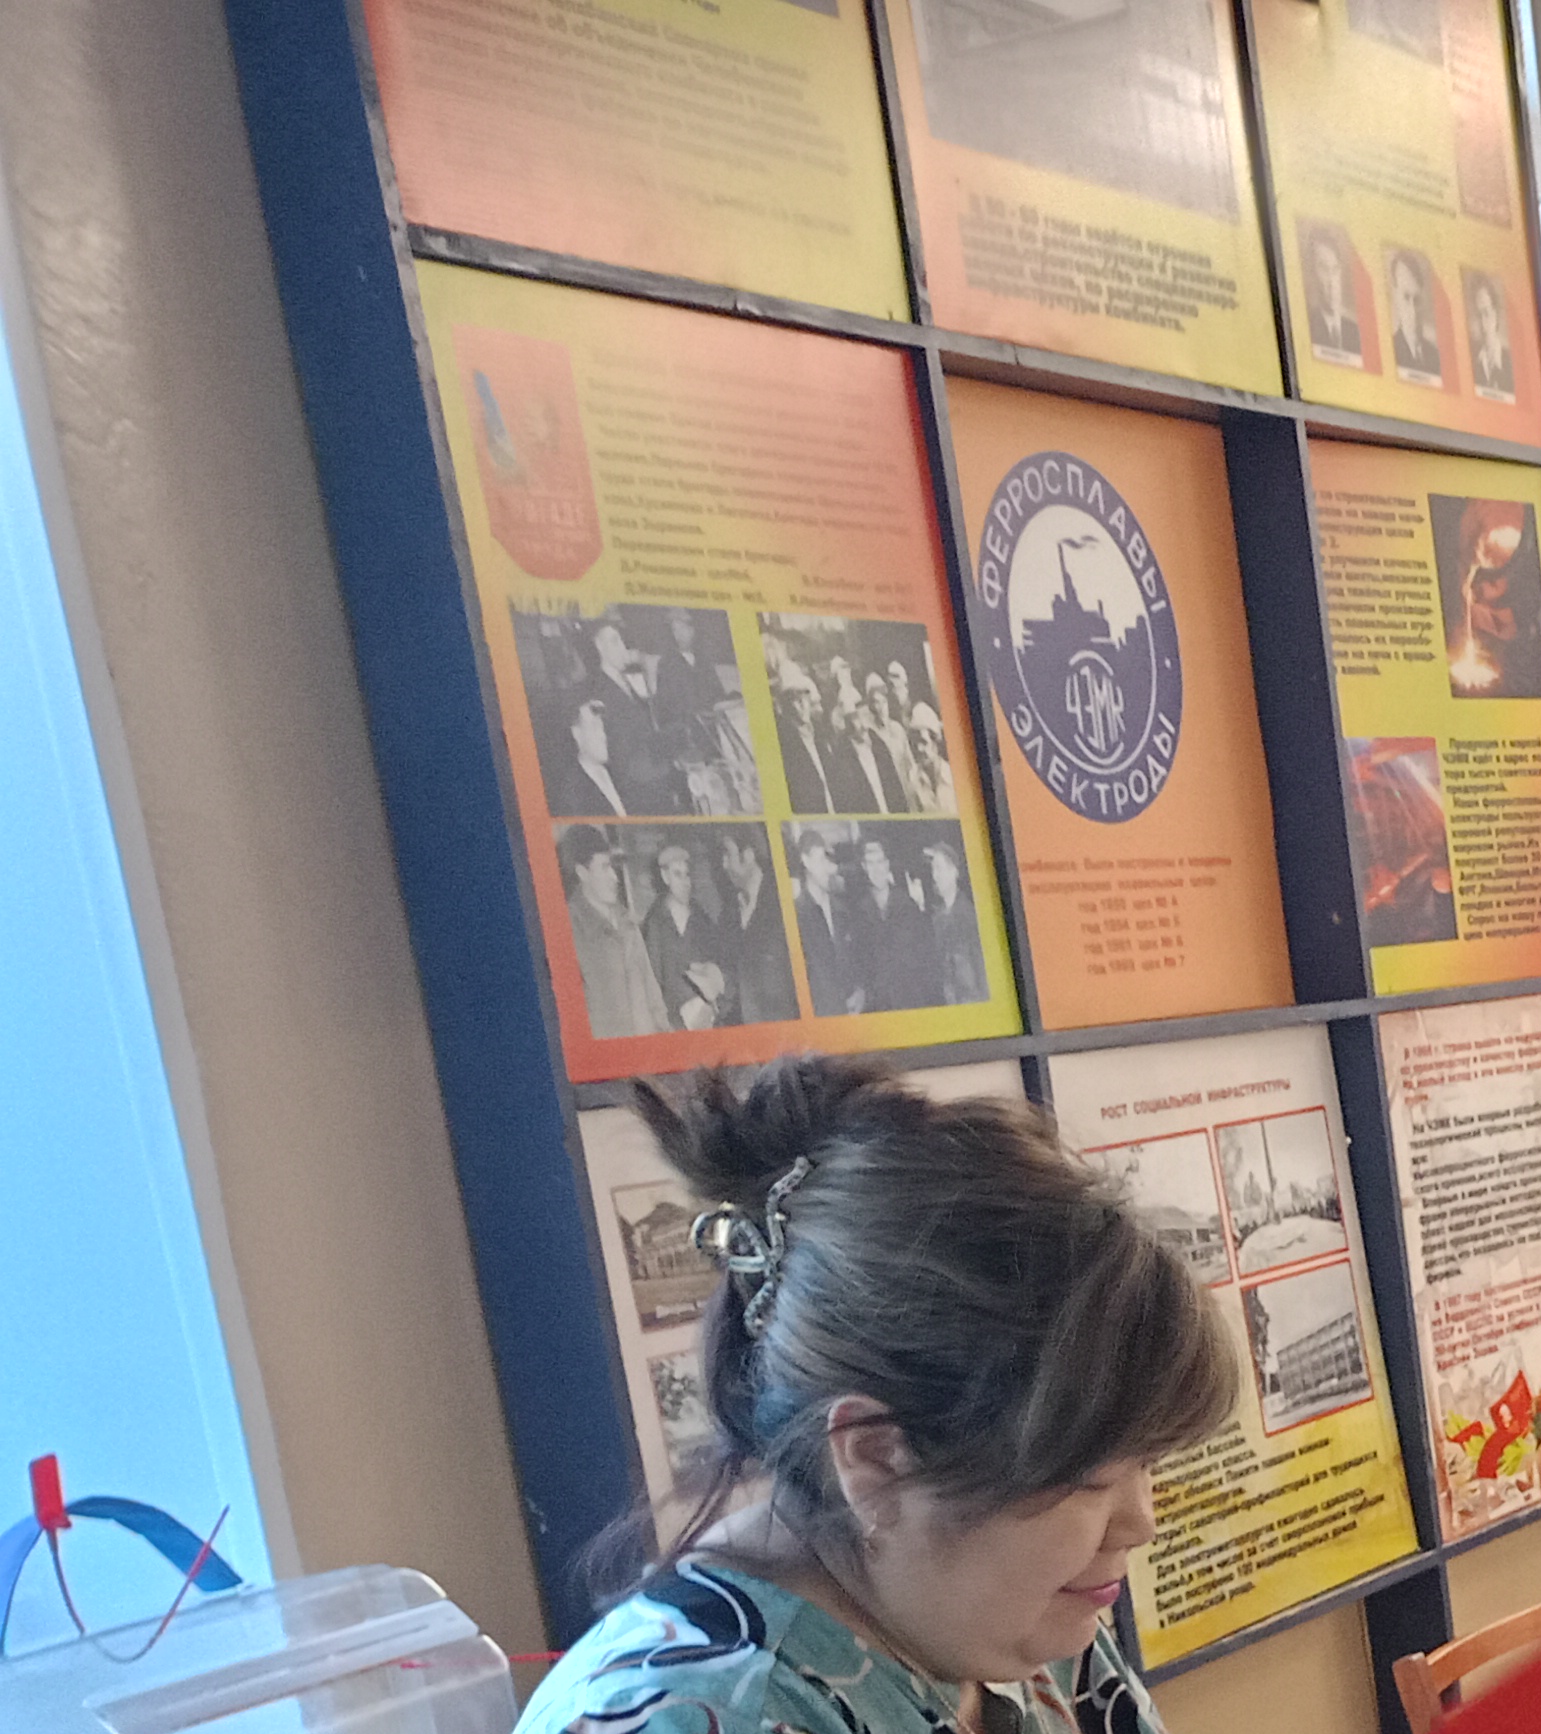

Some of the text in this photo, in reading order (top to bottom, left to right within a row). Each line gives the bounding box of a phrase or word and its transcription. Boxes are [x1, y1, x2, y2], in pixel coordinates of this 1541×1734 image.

[982, 459, 1168, 613] ФЕРРОСПЛАВЫ
[1011, 704, 1175, 816] ЭЛЕКТРОДЫ
[1100, 1078, 1291, 1120] РОСТ СОЦИАЛЬНОЙ ИНФРАСТРУКТУРЫ
[1157, 1561, 1176, 1579] Для
[1167, 1593, 1226, 1624] Никольской
